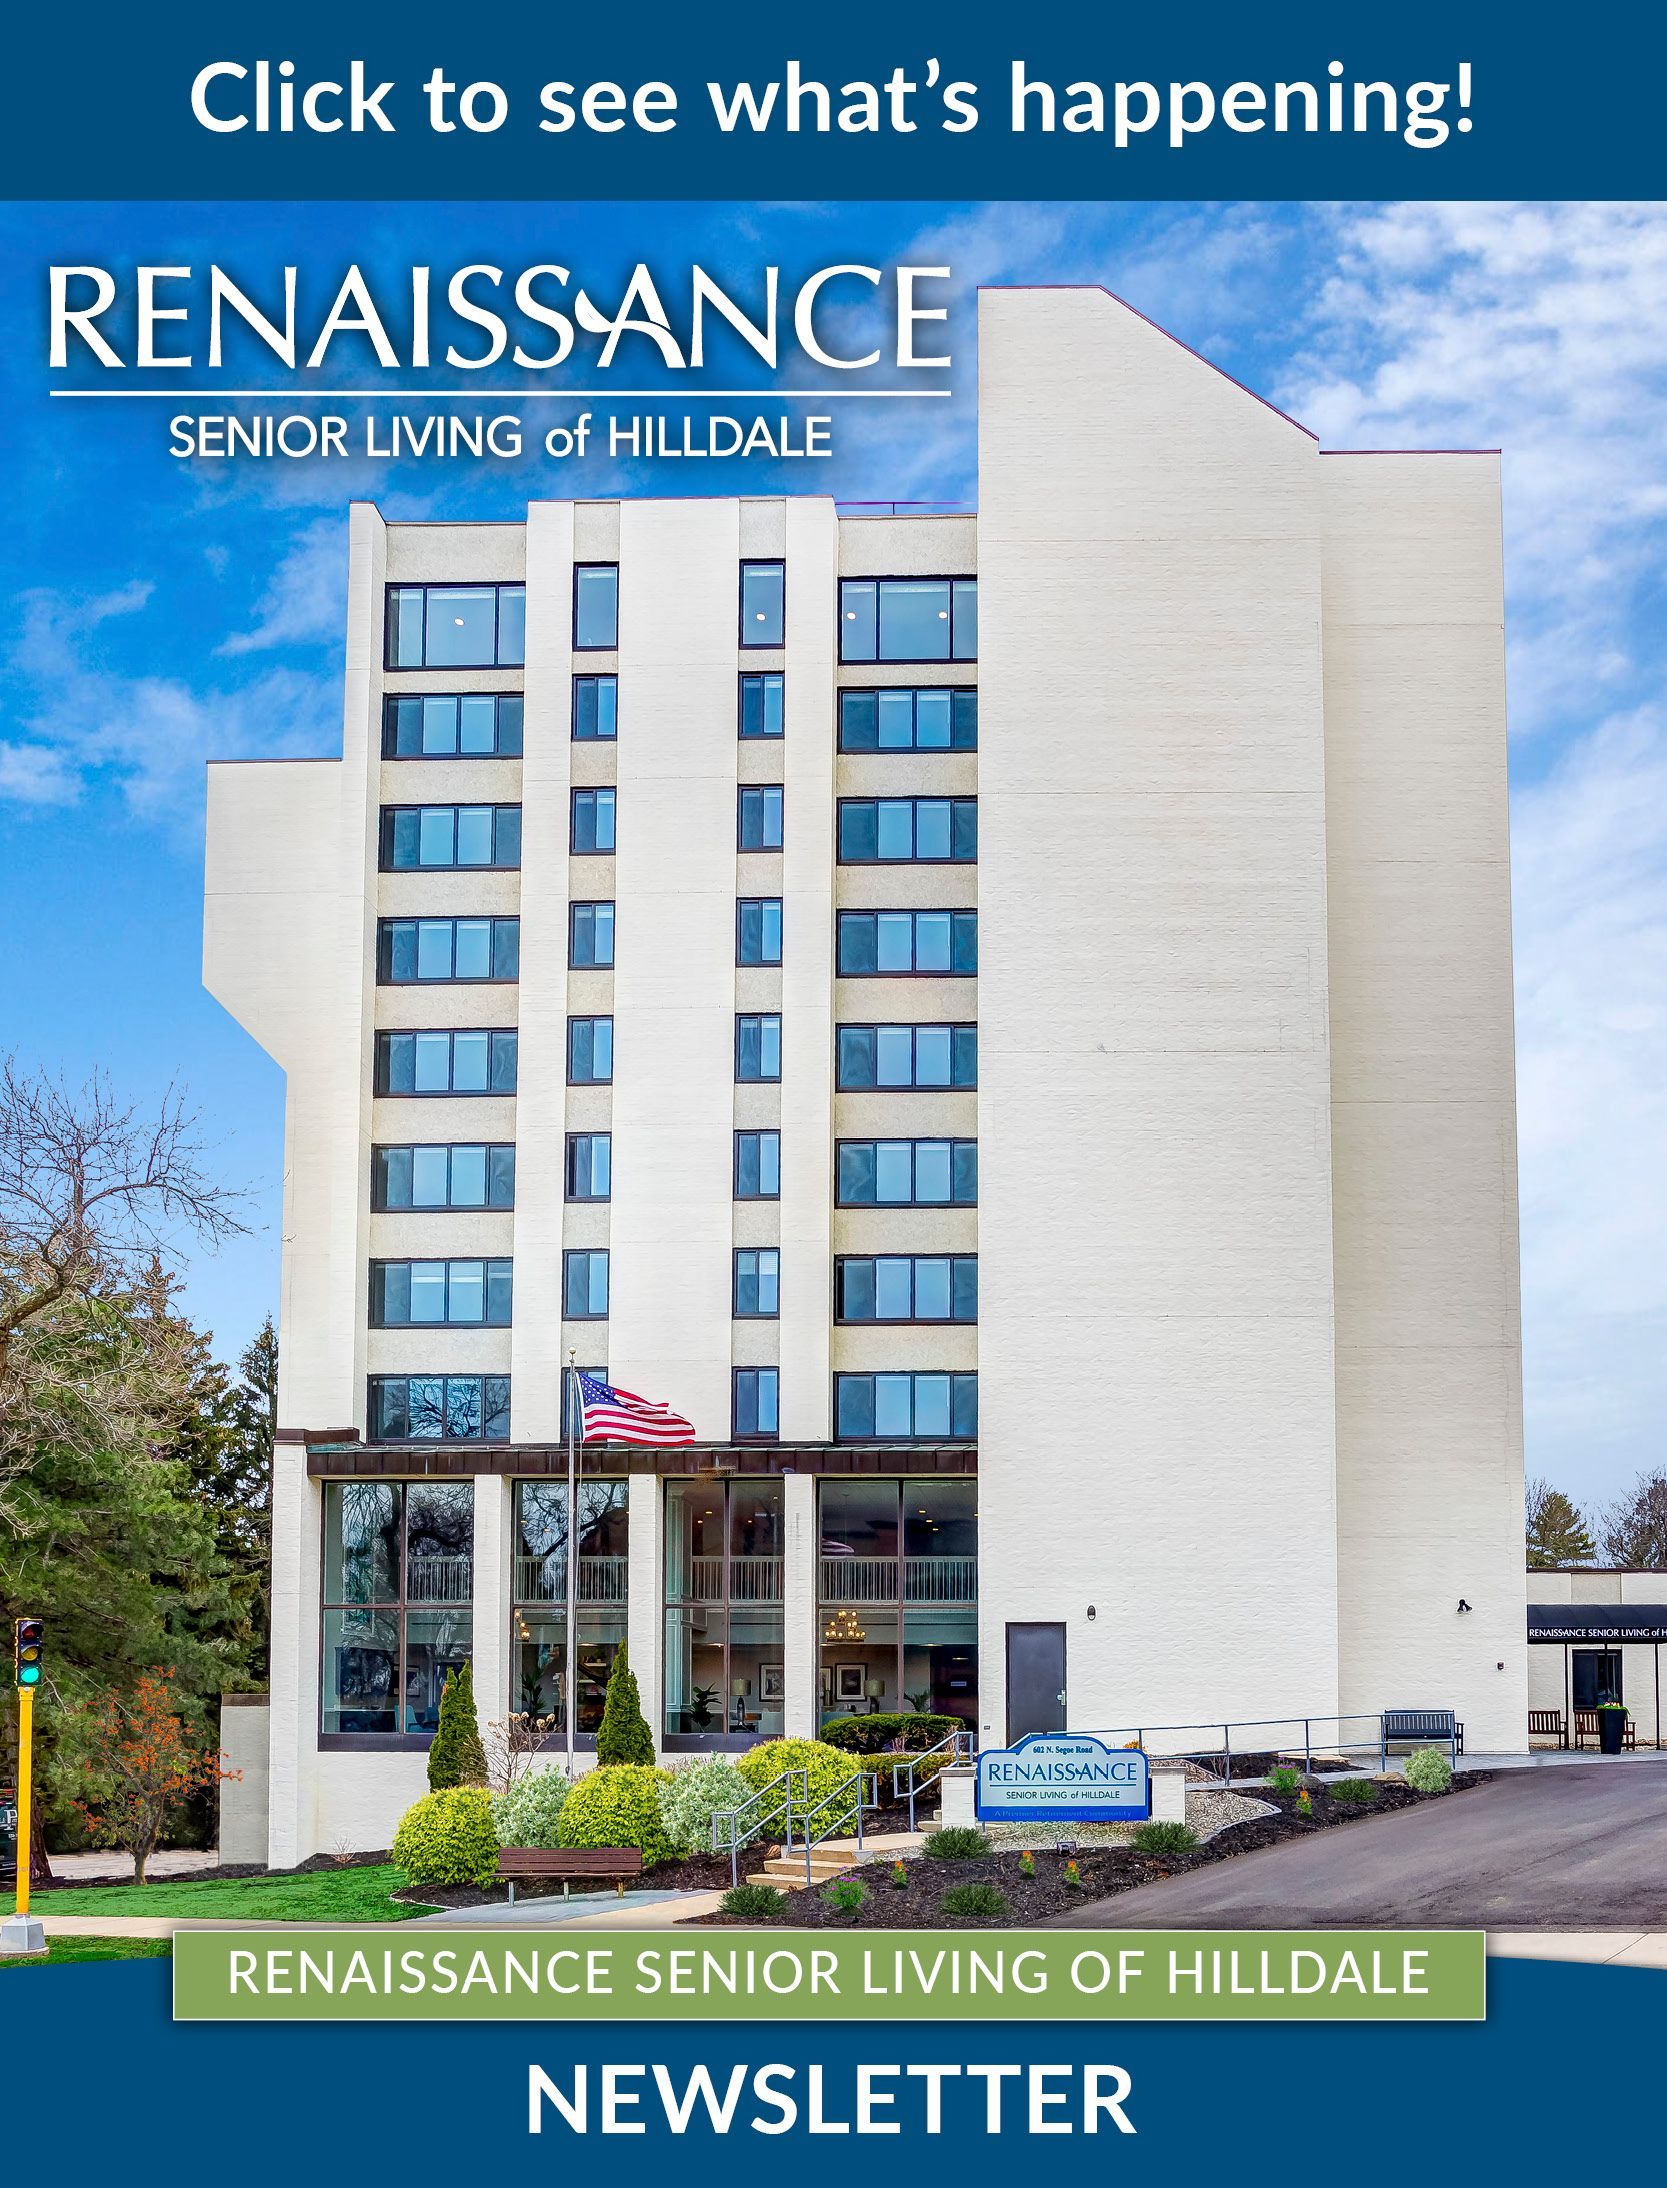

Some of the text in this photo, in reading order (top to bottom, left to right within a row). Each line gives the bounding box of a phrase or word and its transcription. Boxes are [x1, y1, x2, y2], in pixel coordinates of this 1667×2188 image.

[1529, 1628, 1587, 1637] RENAISSANCE
[1588, 1628, 1620, 1637] SENIOR
[1621, 1628, 1650, 1637] LIVING
[1651, 1628, 1660, 1637] of
[1055, 1746, 1074, 1755] Segoe
[988, 1763, 1137, 1781] RENAISSANCE
[1006, 1791, 1120, 1799] SENIOR LIVING of HILLDALE
